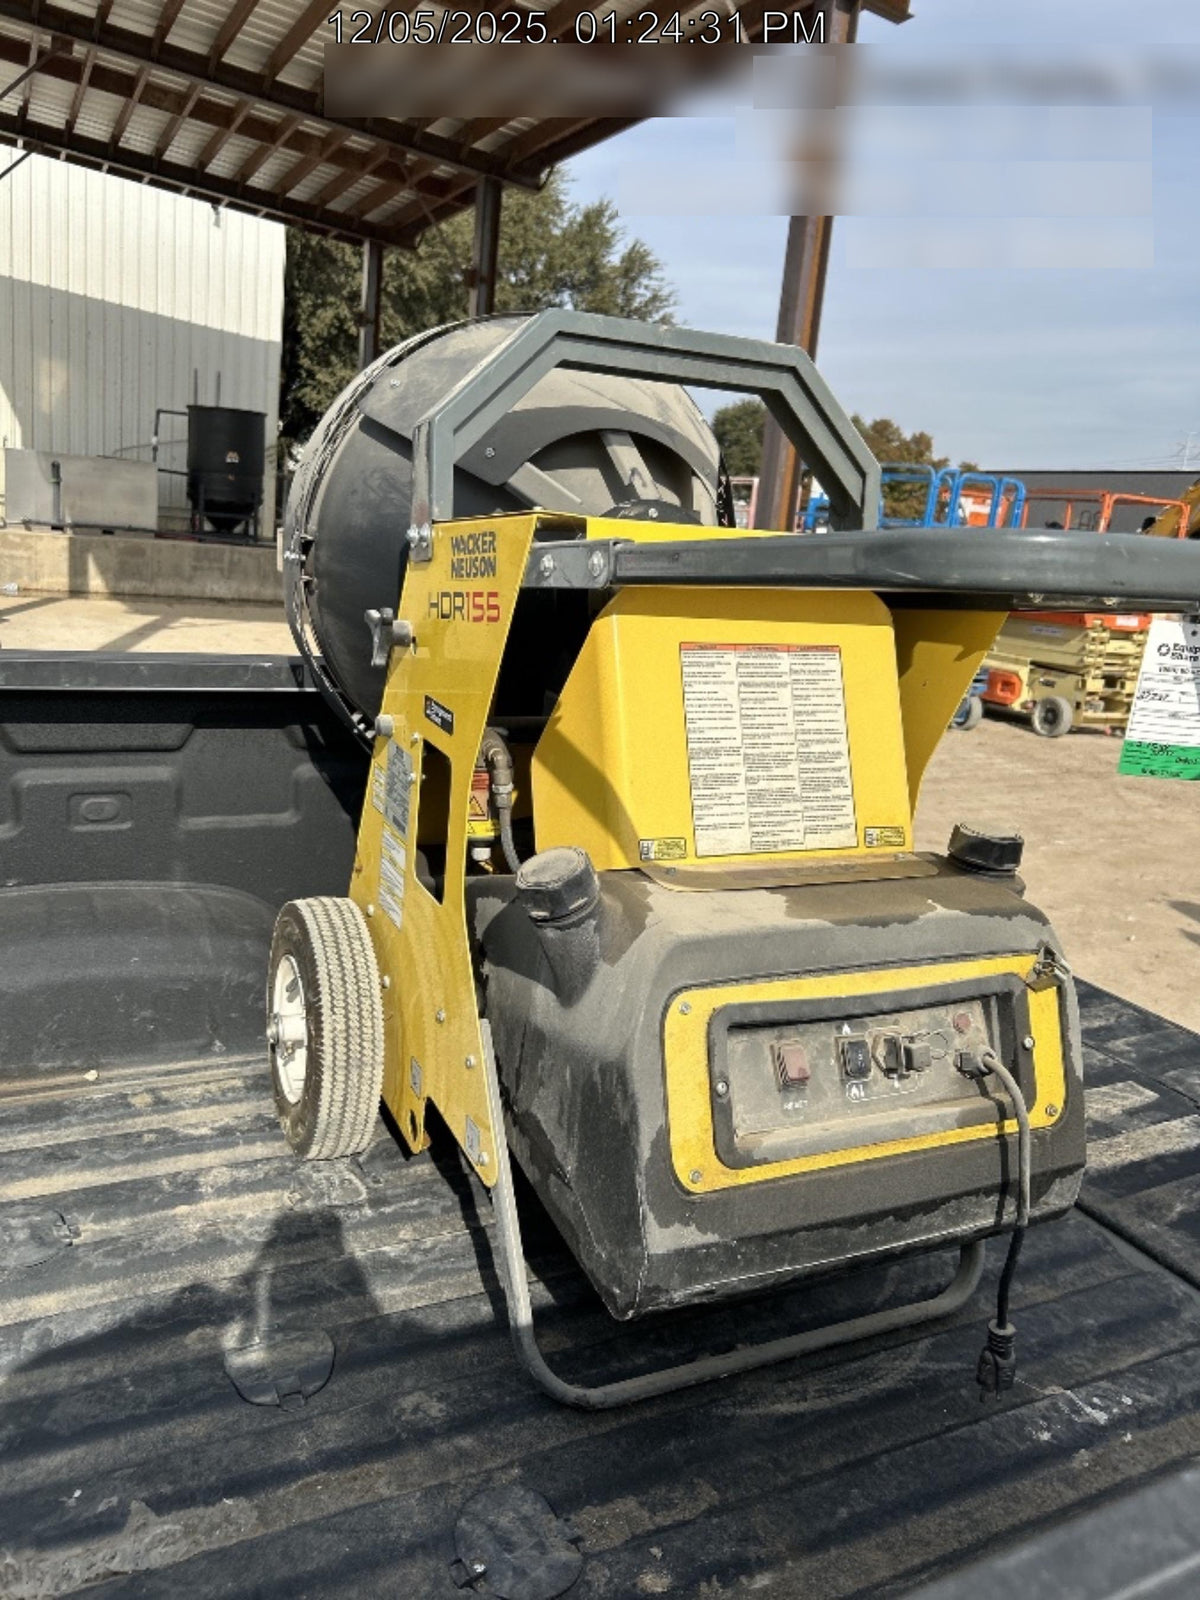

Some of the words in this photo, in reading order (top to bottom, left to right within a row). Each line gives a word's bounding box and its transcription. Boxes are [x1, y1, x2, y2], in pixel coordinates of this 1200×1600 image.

[451, 531, 497, 557] WACKER
[451, 556, 497, 579] NEUSON
[428, 591, 501, 623] HDR155
